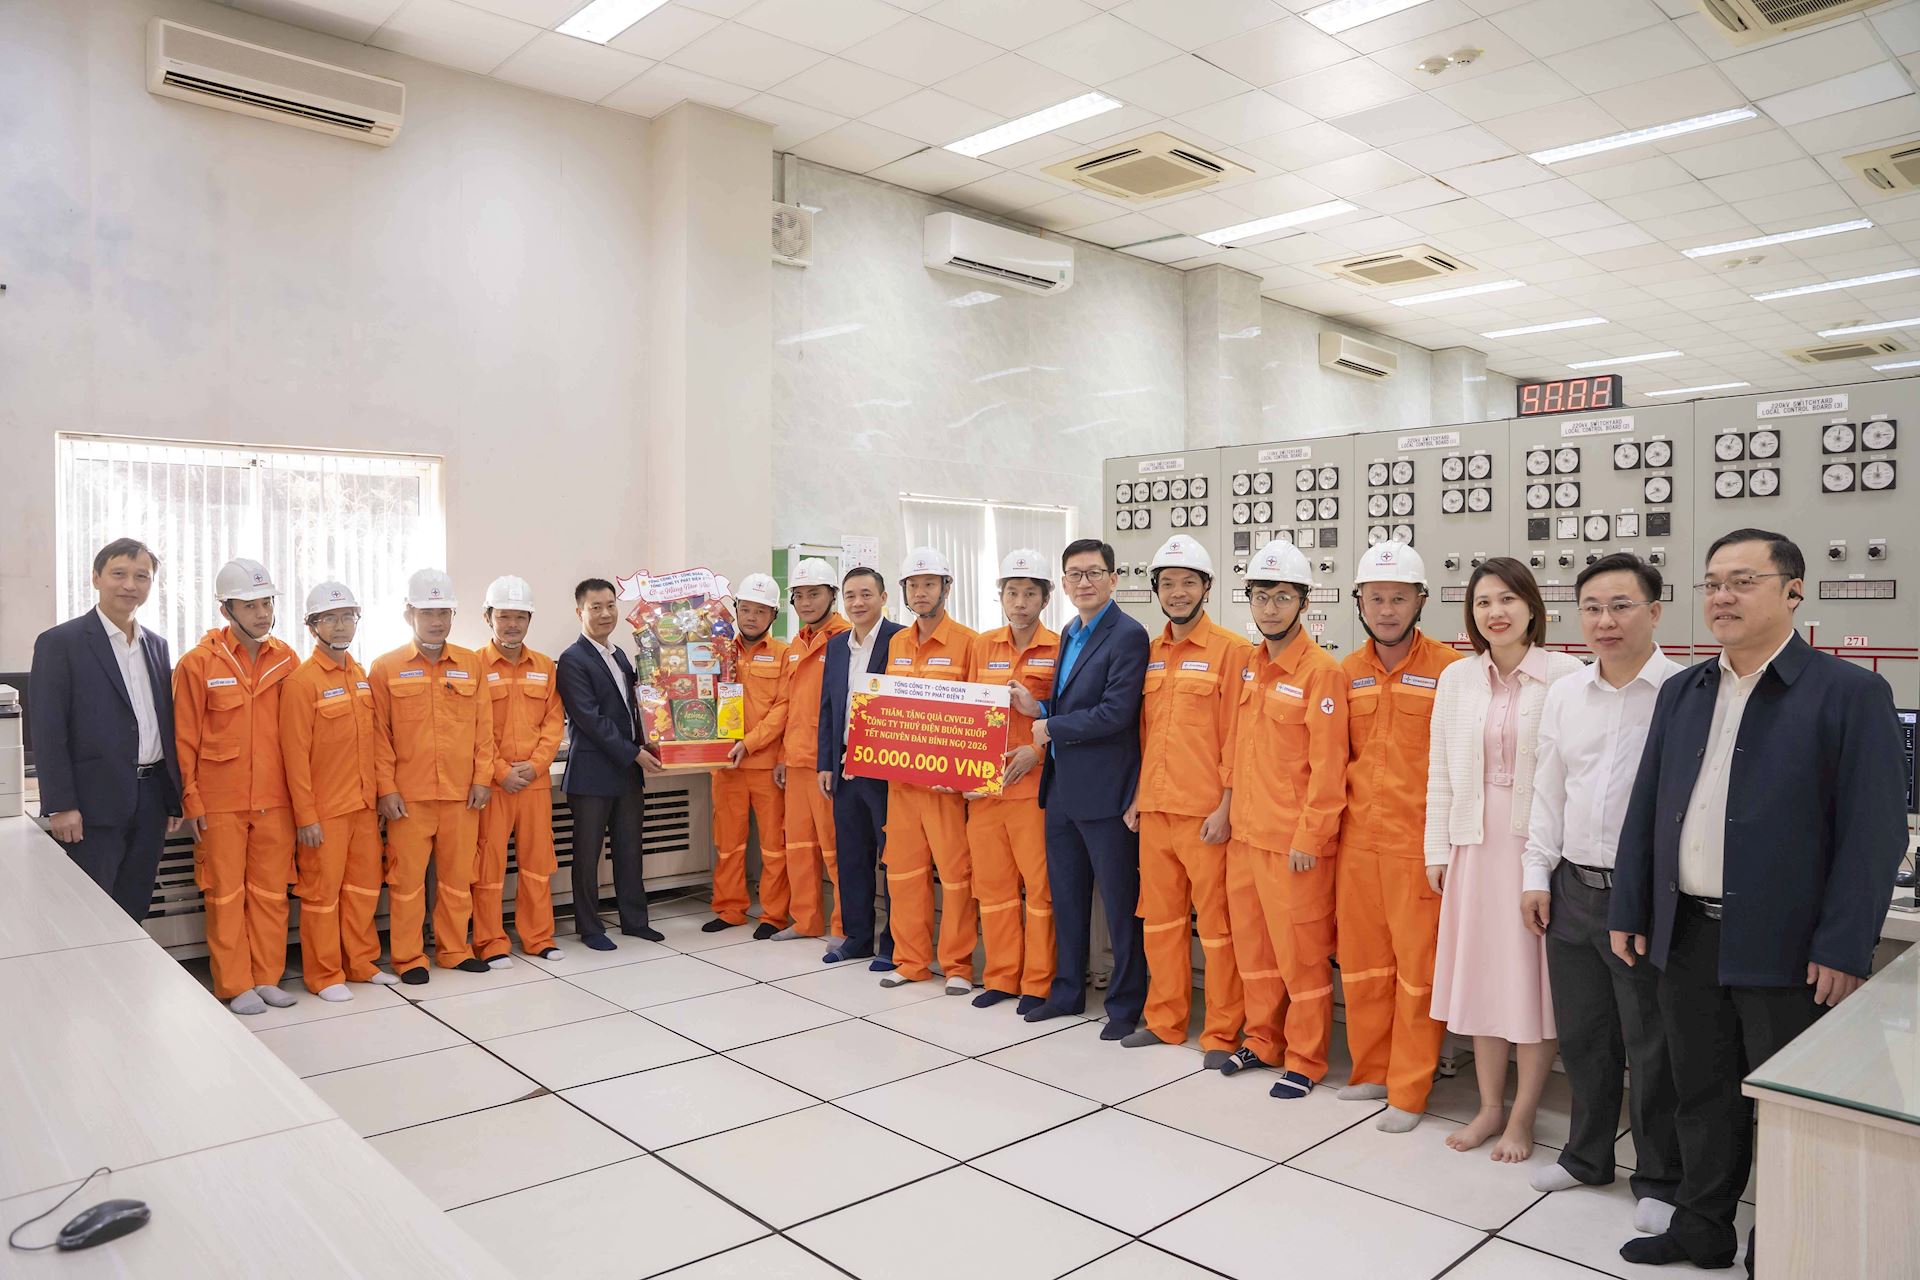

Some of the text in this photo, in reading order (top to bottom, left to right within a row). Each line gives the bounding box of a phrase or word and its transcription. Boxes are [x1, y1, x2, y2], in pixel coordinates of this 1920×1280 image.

[1520, 376, 1612, 414] 50.02
[1761, 408, 1780, 416] LOCAL
[1783, 405, 1810, 413] CONTROL
[1812, 402, 1833, 411] BOARD
[1771, 397, 1834, 409] 220kV SWITCHYARD
[1590, 419, 1623, 427] SWITCHYARD
[1846, 637, 1865, 646] 271
[908, 682, 924, 690] CÔNG
[934, 684, 950, 692] CÔNG
[950, 685, 967, 693] ĐOÀN
[908, 689, 924, 697] CÔNG
[932, 691, 946, 699] PHÁT
[946, 692, 960, 701] ĐIỆN
[880, 707, 975, 725] THĂM, TẶNG QUÀ CNVCLĐ
[866, 715, 887, 727] CÔNG
[887, 719, 899, 728] TY
[921, 722, 940, 733] ĐIỆN
[941, 725, 964, 736] BUÔN
[964, 727, 988, 738] KUỐP
[864, 727, 988, 751] TẾT NGUYÊN ĐÁN BÍNH NGỌ 2026
[853, 745, 996, 779] 50.000.000 VNĐ
